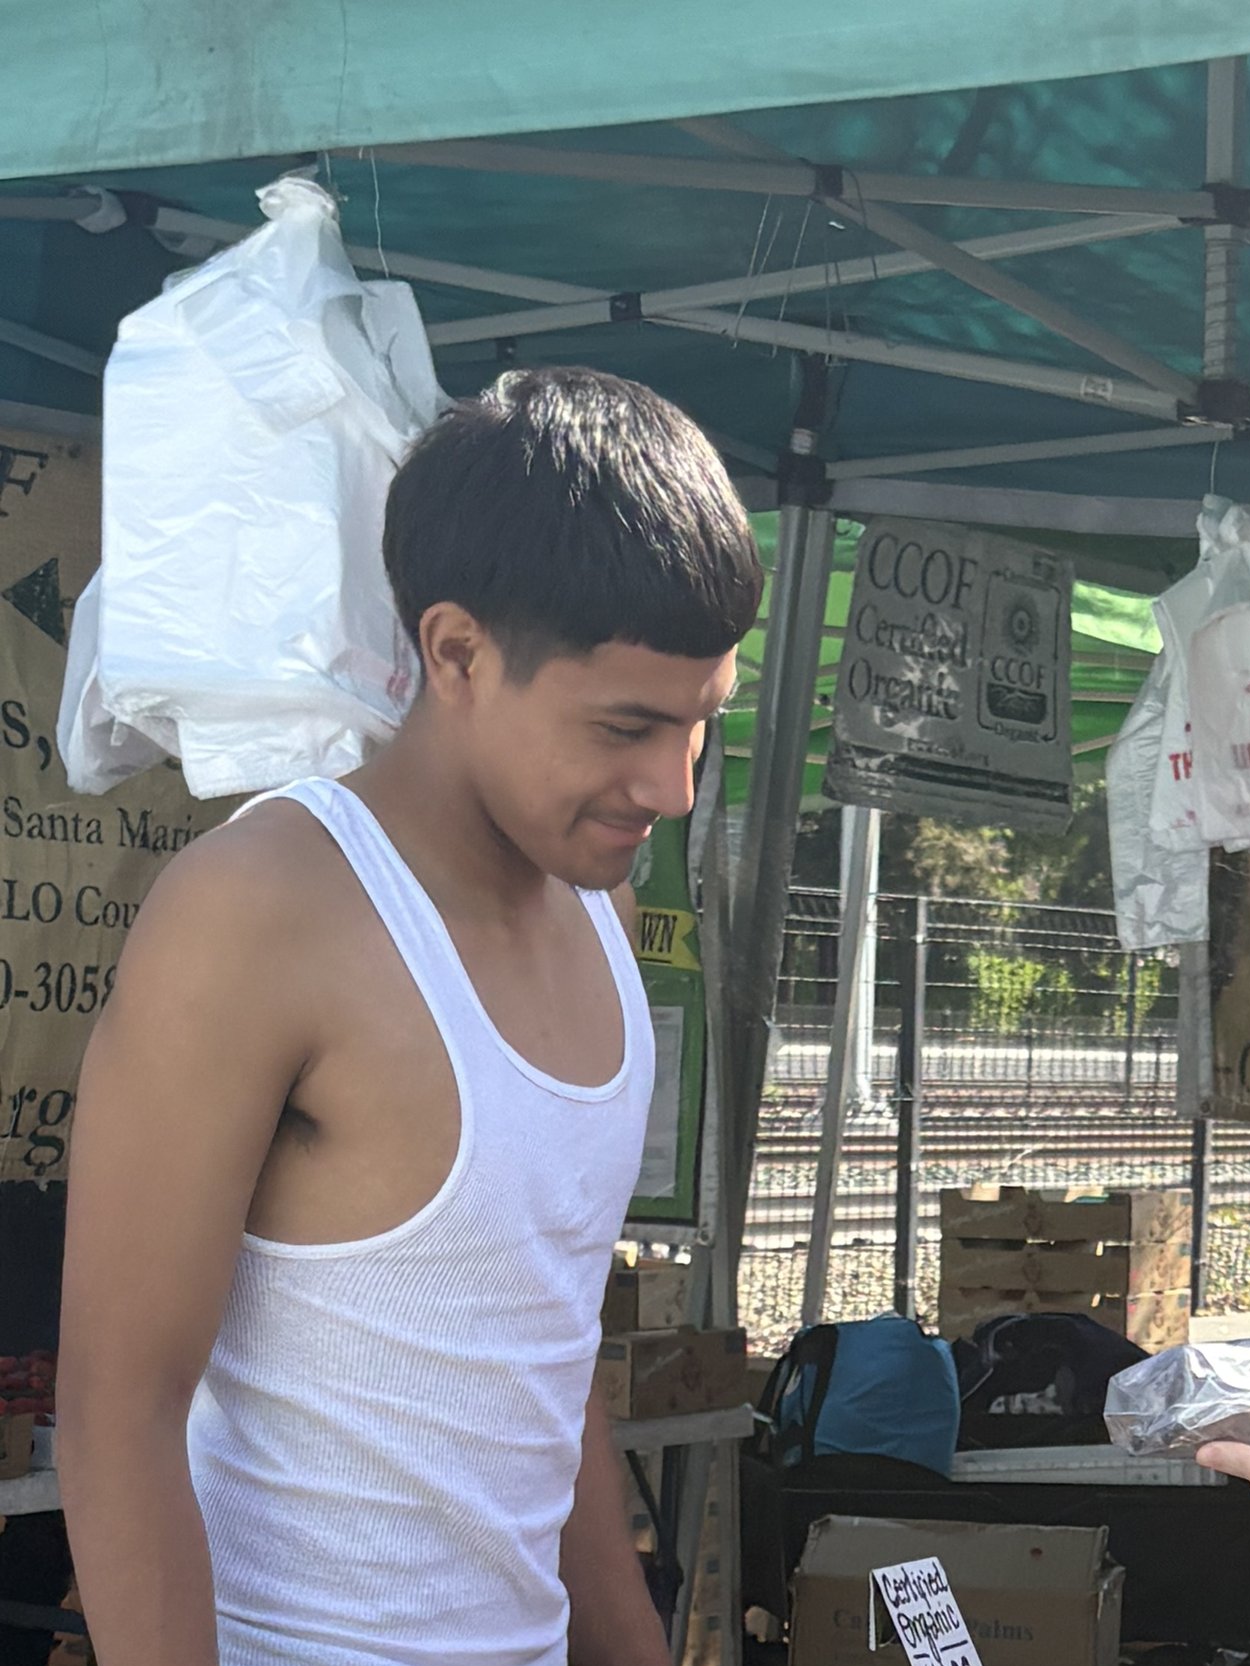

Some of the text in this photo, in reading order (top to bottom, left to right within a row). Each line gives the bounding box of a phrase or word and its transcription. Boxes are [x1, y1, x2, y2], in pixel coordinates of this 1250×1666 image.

[868, 533, 978, 609] CCOF
[990, 655, 1046, 689] CCOF
[4, 796, 104, 845] Santa
[882, 1562, 948, 1609] Certified
[897, 1602, 960, 1662] Organic
